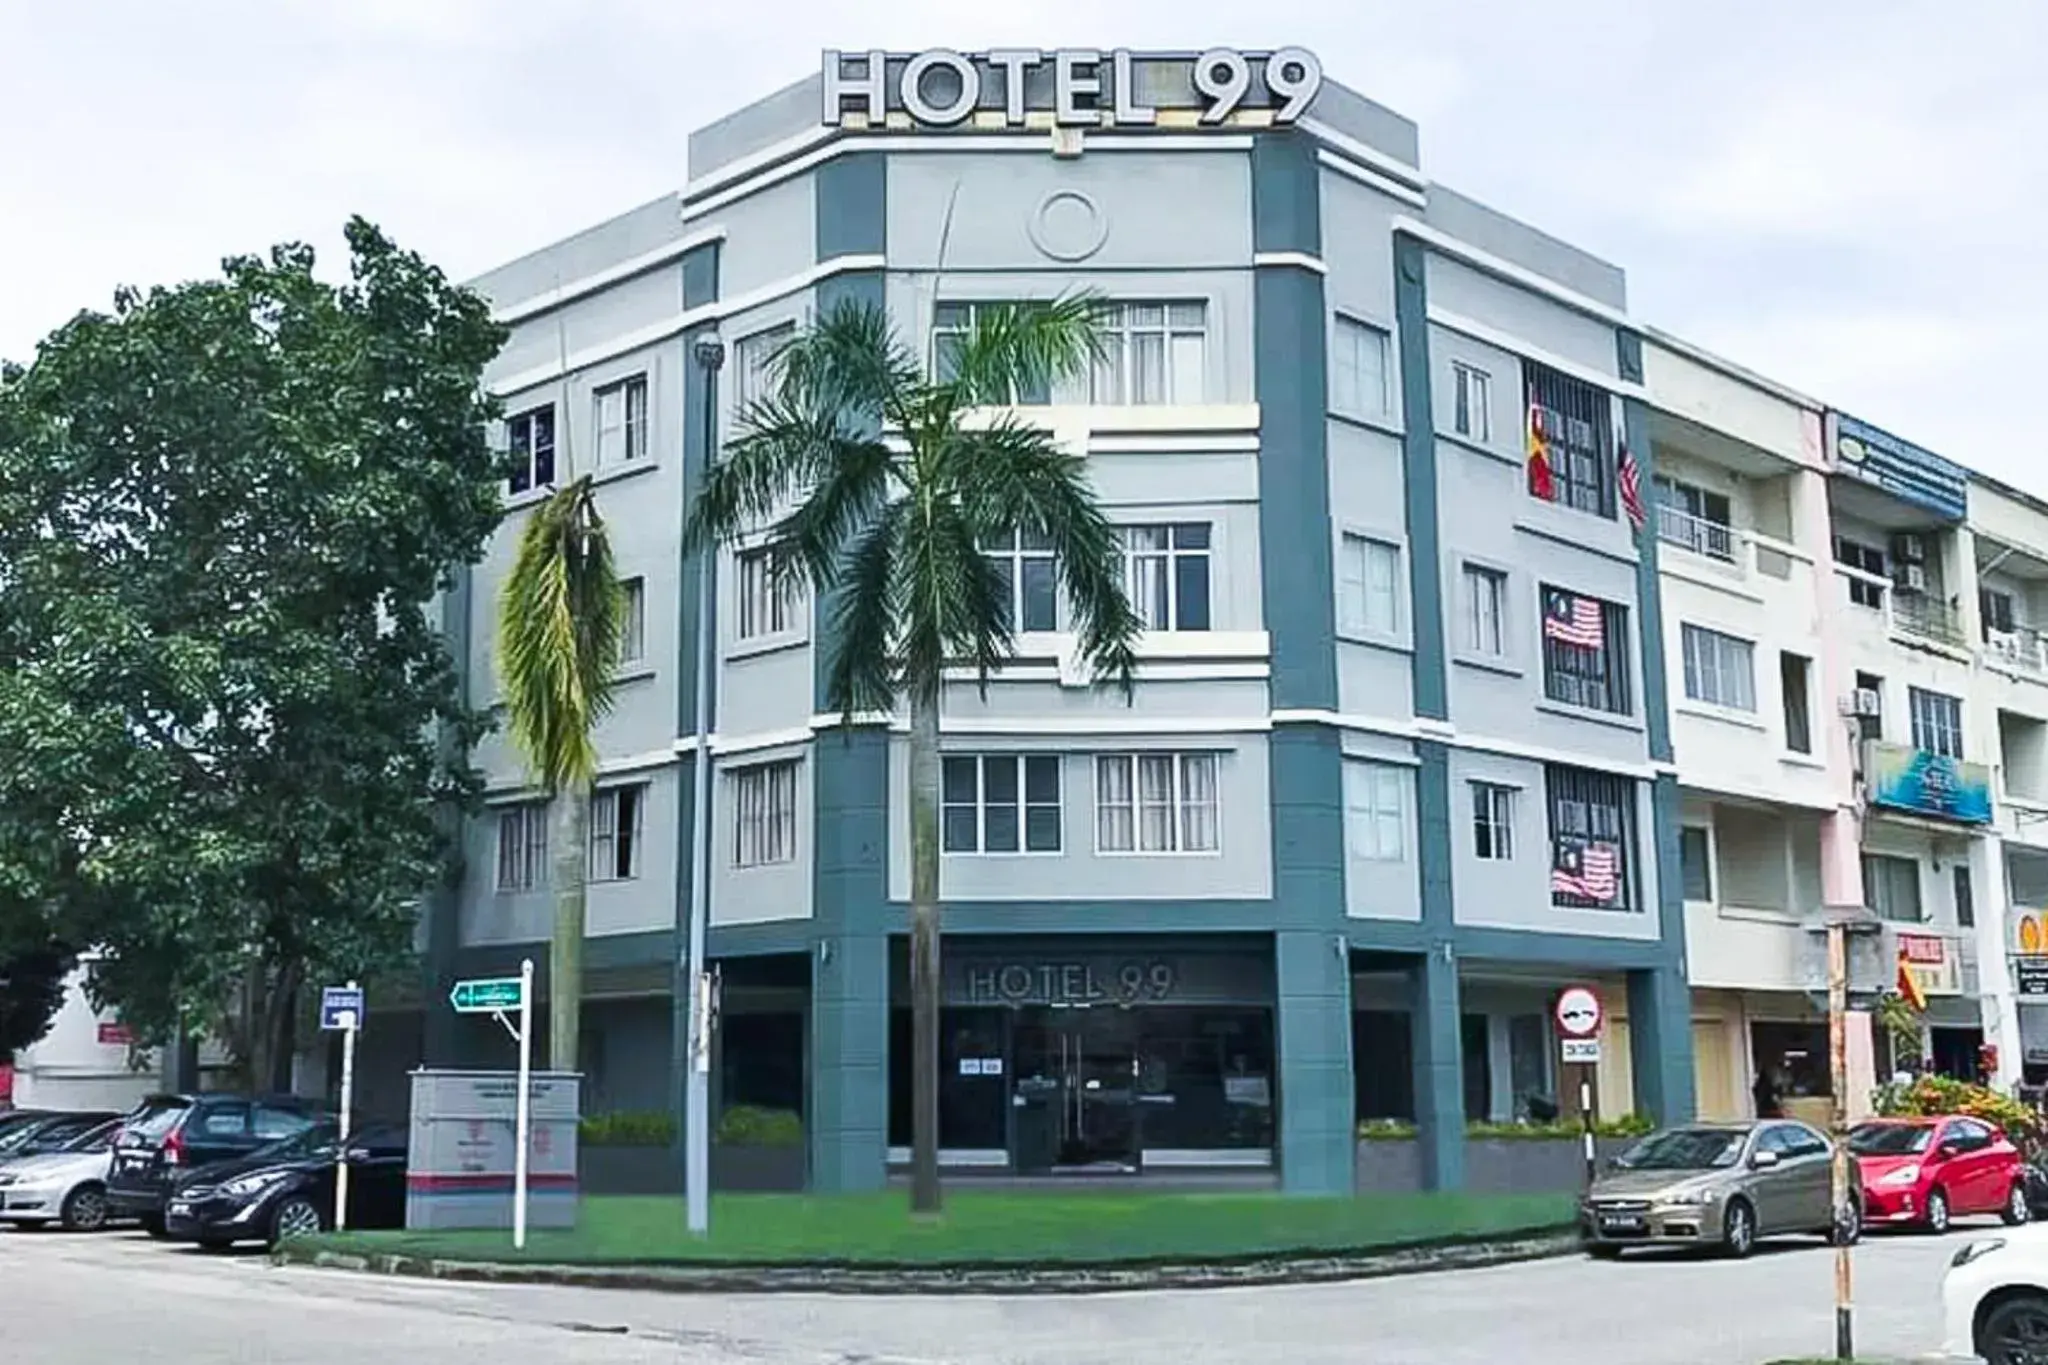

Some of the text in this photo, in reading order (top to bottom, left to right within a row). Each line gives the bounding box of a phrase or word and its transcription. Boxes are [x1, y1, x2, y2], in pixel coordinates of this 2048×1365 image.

[822, 46, 1323, 126] HOTEL 99
[969, 964, 1173, 1001] HOTEL 99
